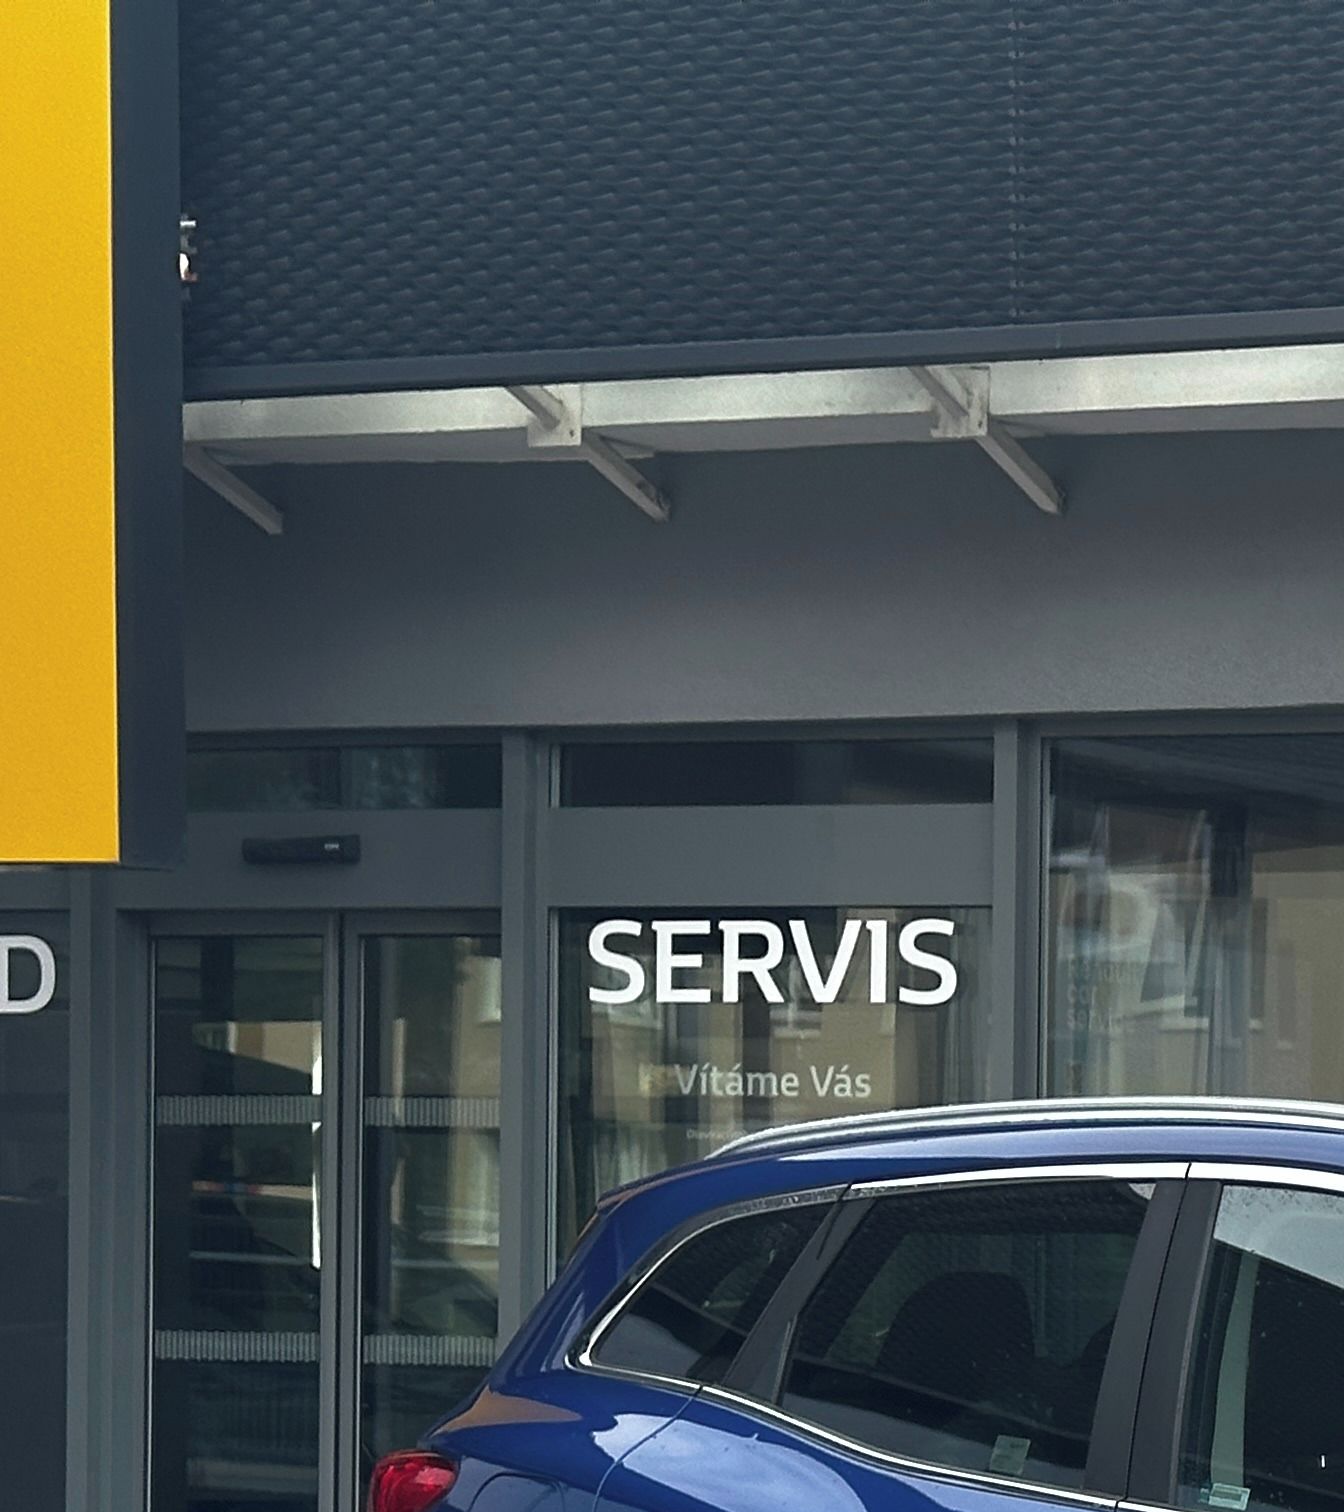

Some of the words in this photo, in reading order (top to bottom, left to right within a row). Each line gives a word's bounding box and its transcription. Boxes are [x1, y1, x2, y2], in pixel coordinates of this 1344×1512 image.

[588, 918, 958, 1005] SERVIS
[674, 1062, 800, 1098] Vítáme
[810, 1064, 872, 1098] Vás
